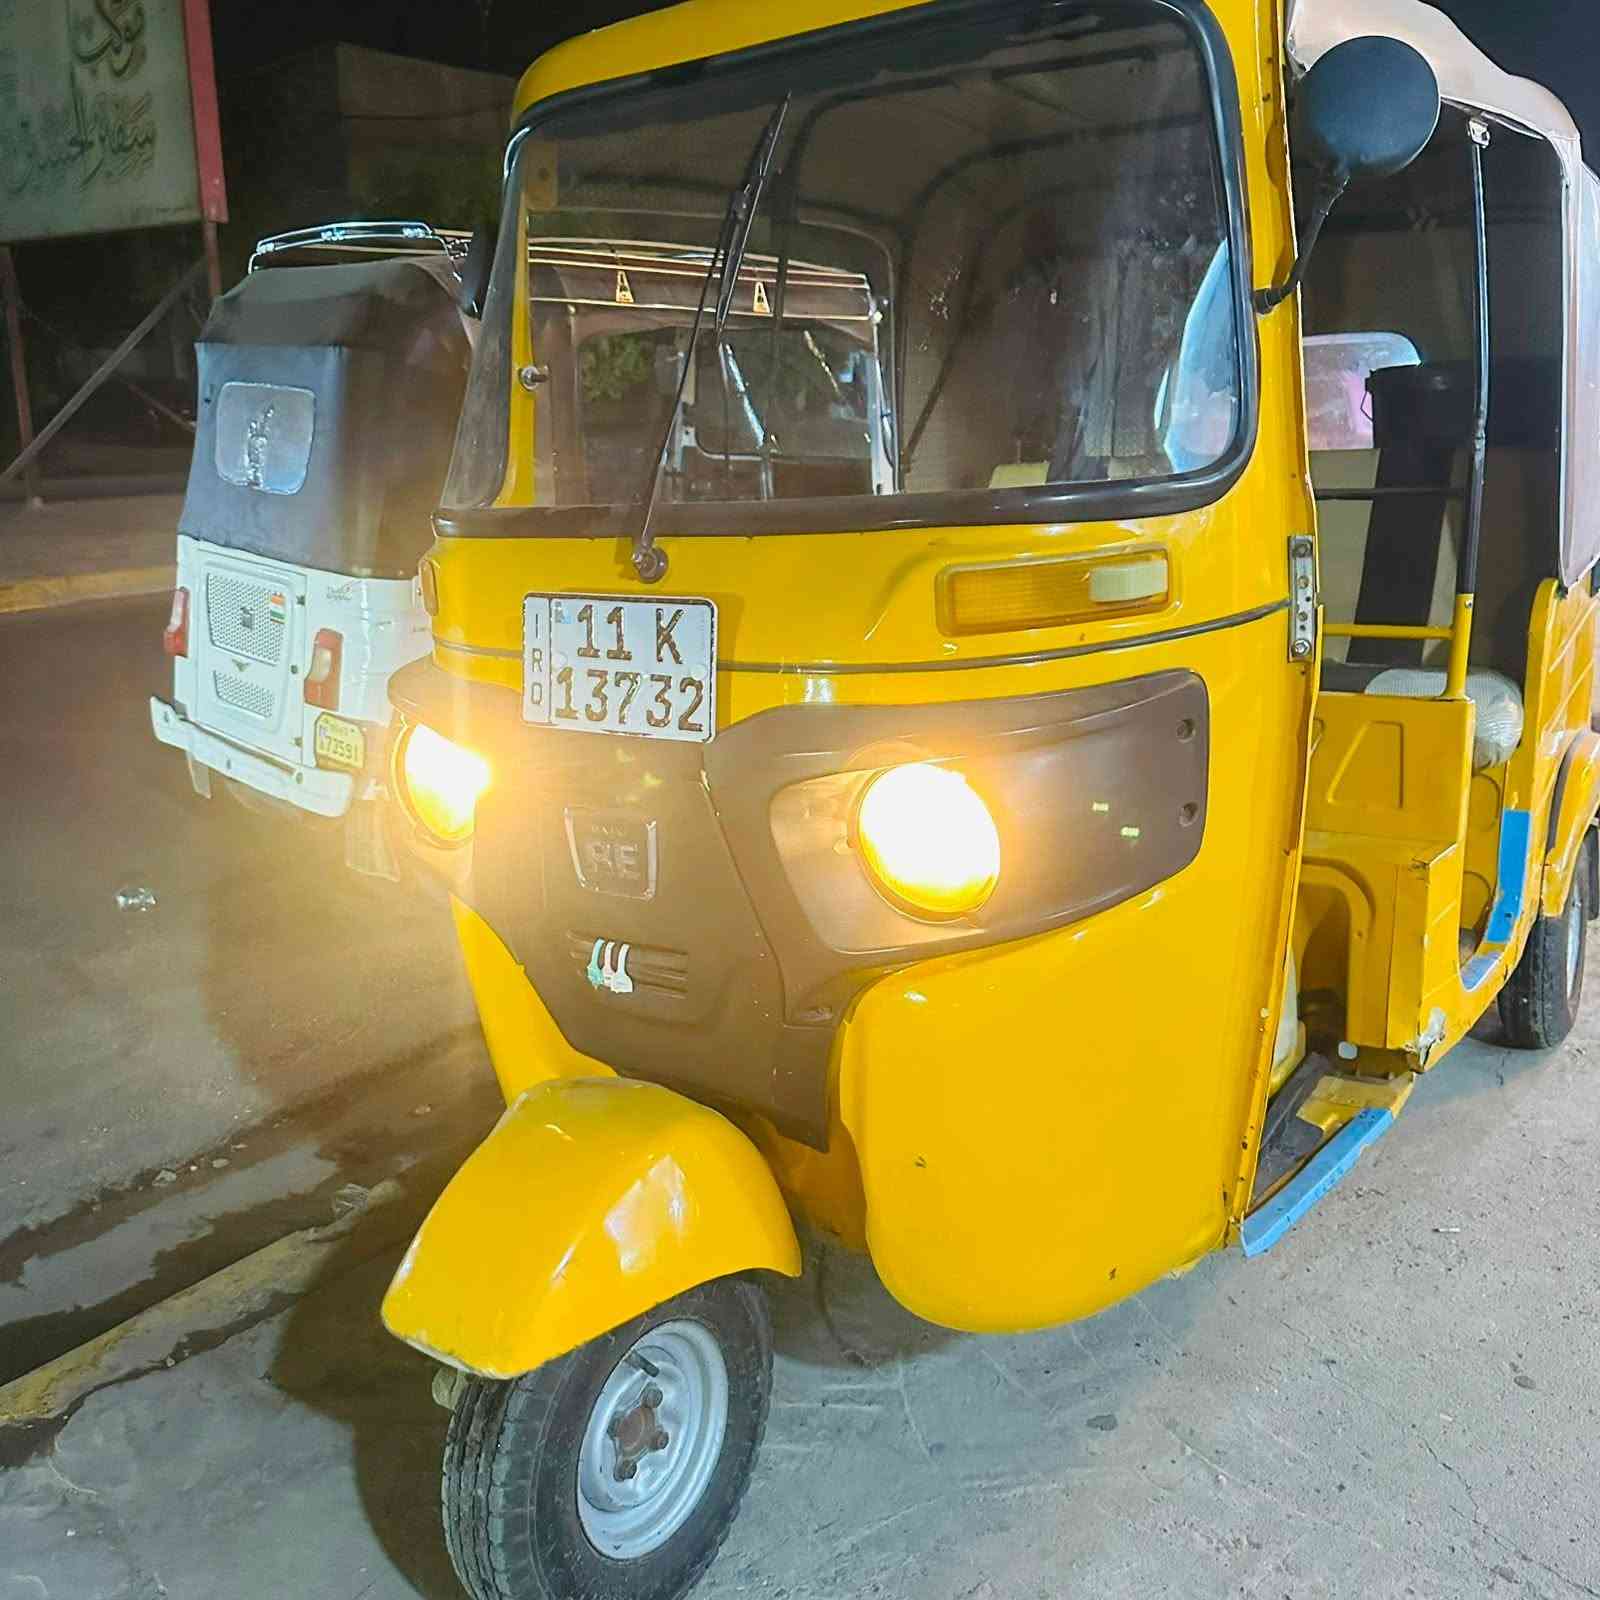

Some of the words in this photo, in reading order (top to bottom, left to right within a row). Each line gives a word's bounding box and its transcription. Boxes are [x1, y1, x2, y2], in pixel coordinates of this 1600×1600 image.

[577, 604, 632, 661] 11
[655, 607, 684, 665] K
[555, 666, 704, 732] 13732
